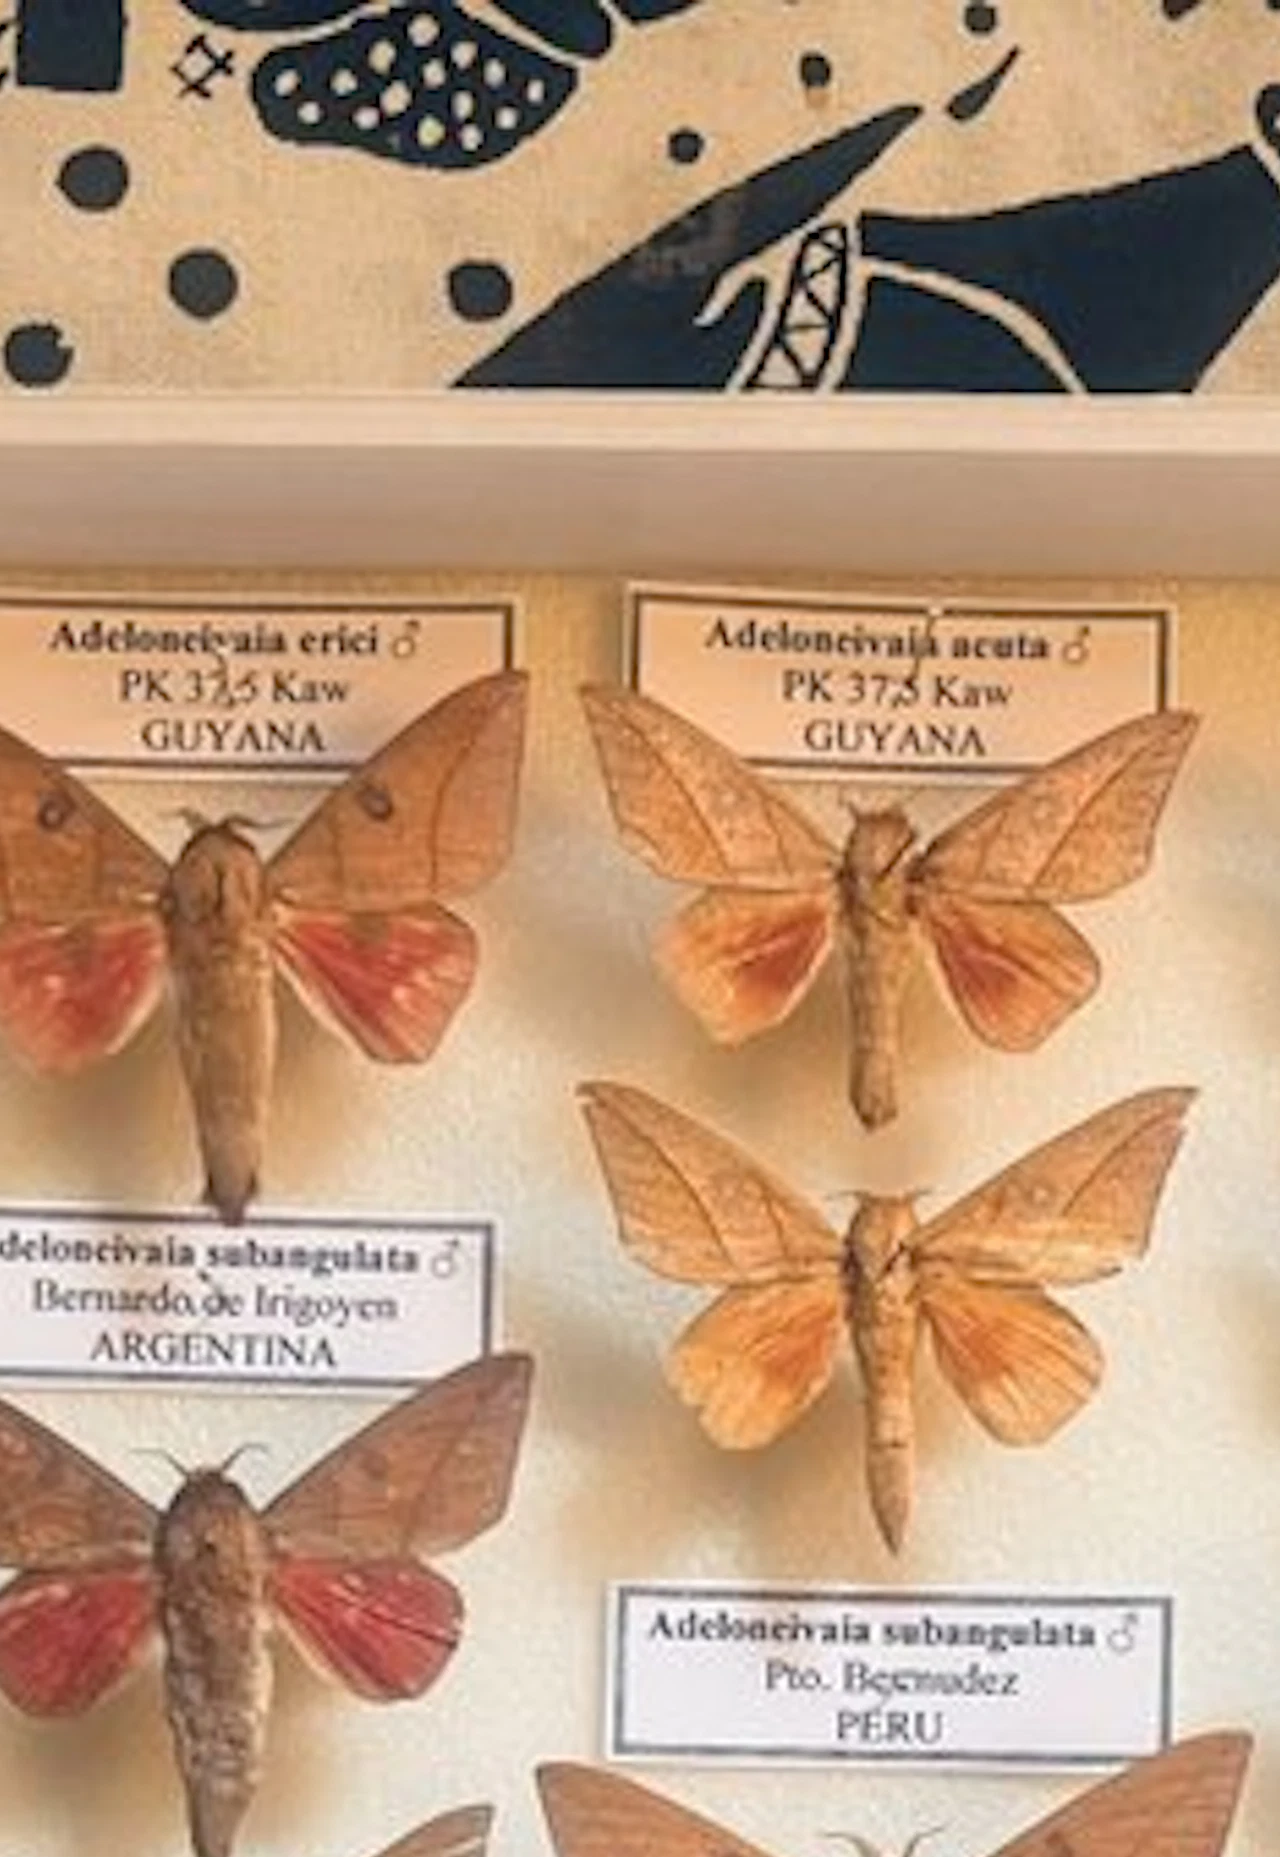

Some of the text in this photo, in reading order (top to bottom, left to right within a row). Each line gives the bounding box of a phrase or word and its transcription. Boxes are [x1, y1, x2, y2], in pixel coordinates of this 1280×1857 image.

[300, 622, 377, 654] erici
[952, 630, 1047, 659] acuta
[122, 671, 173, 702] PK
[271, 672, 349, 702] Kaw
[783, 671, 835, 702] PK
[934, 676, 1012, 708] Kaw
[142, 719, 325, 753] GUYANA
[804, 719, 986, 756] GUYANA
[207, 1240, 418, 1276] subangulata
[205, 1283, 243, 1317] de
[255, 1285, 397, 1328] Irigoyen
[90, 1331, 336, 1368] ARGENTINA
[882, 1616, 1096, 1652] subangulata
[765, 1661, 826, 1692] Pto.
[836, 1710, 944, 1745] PERU
